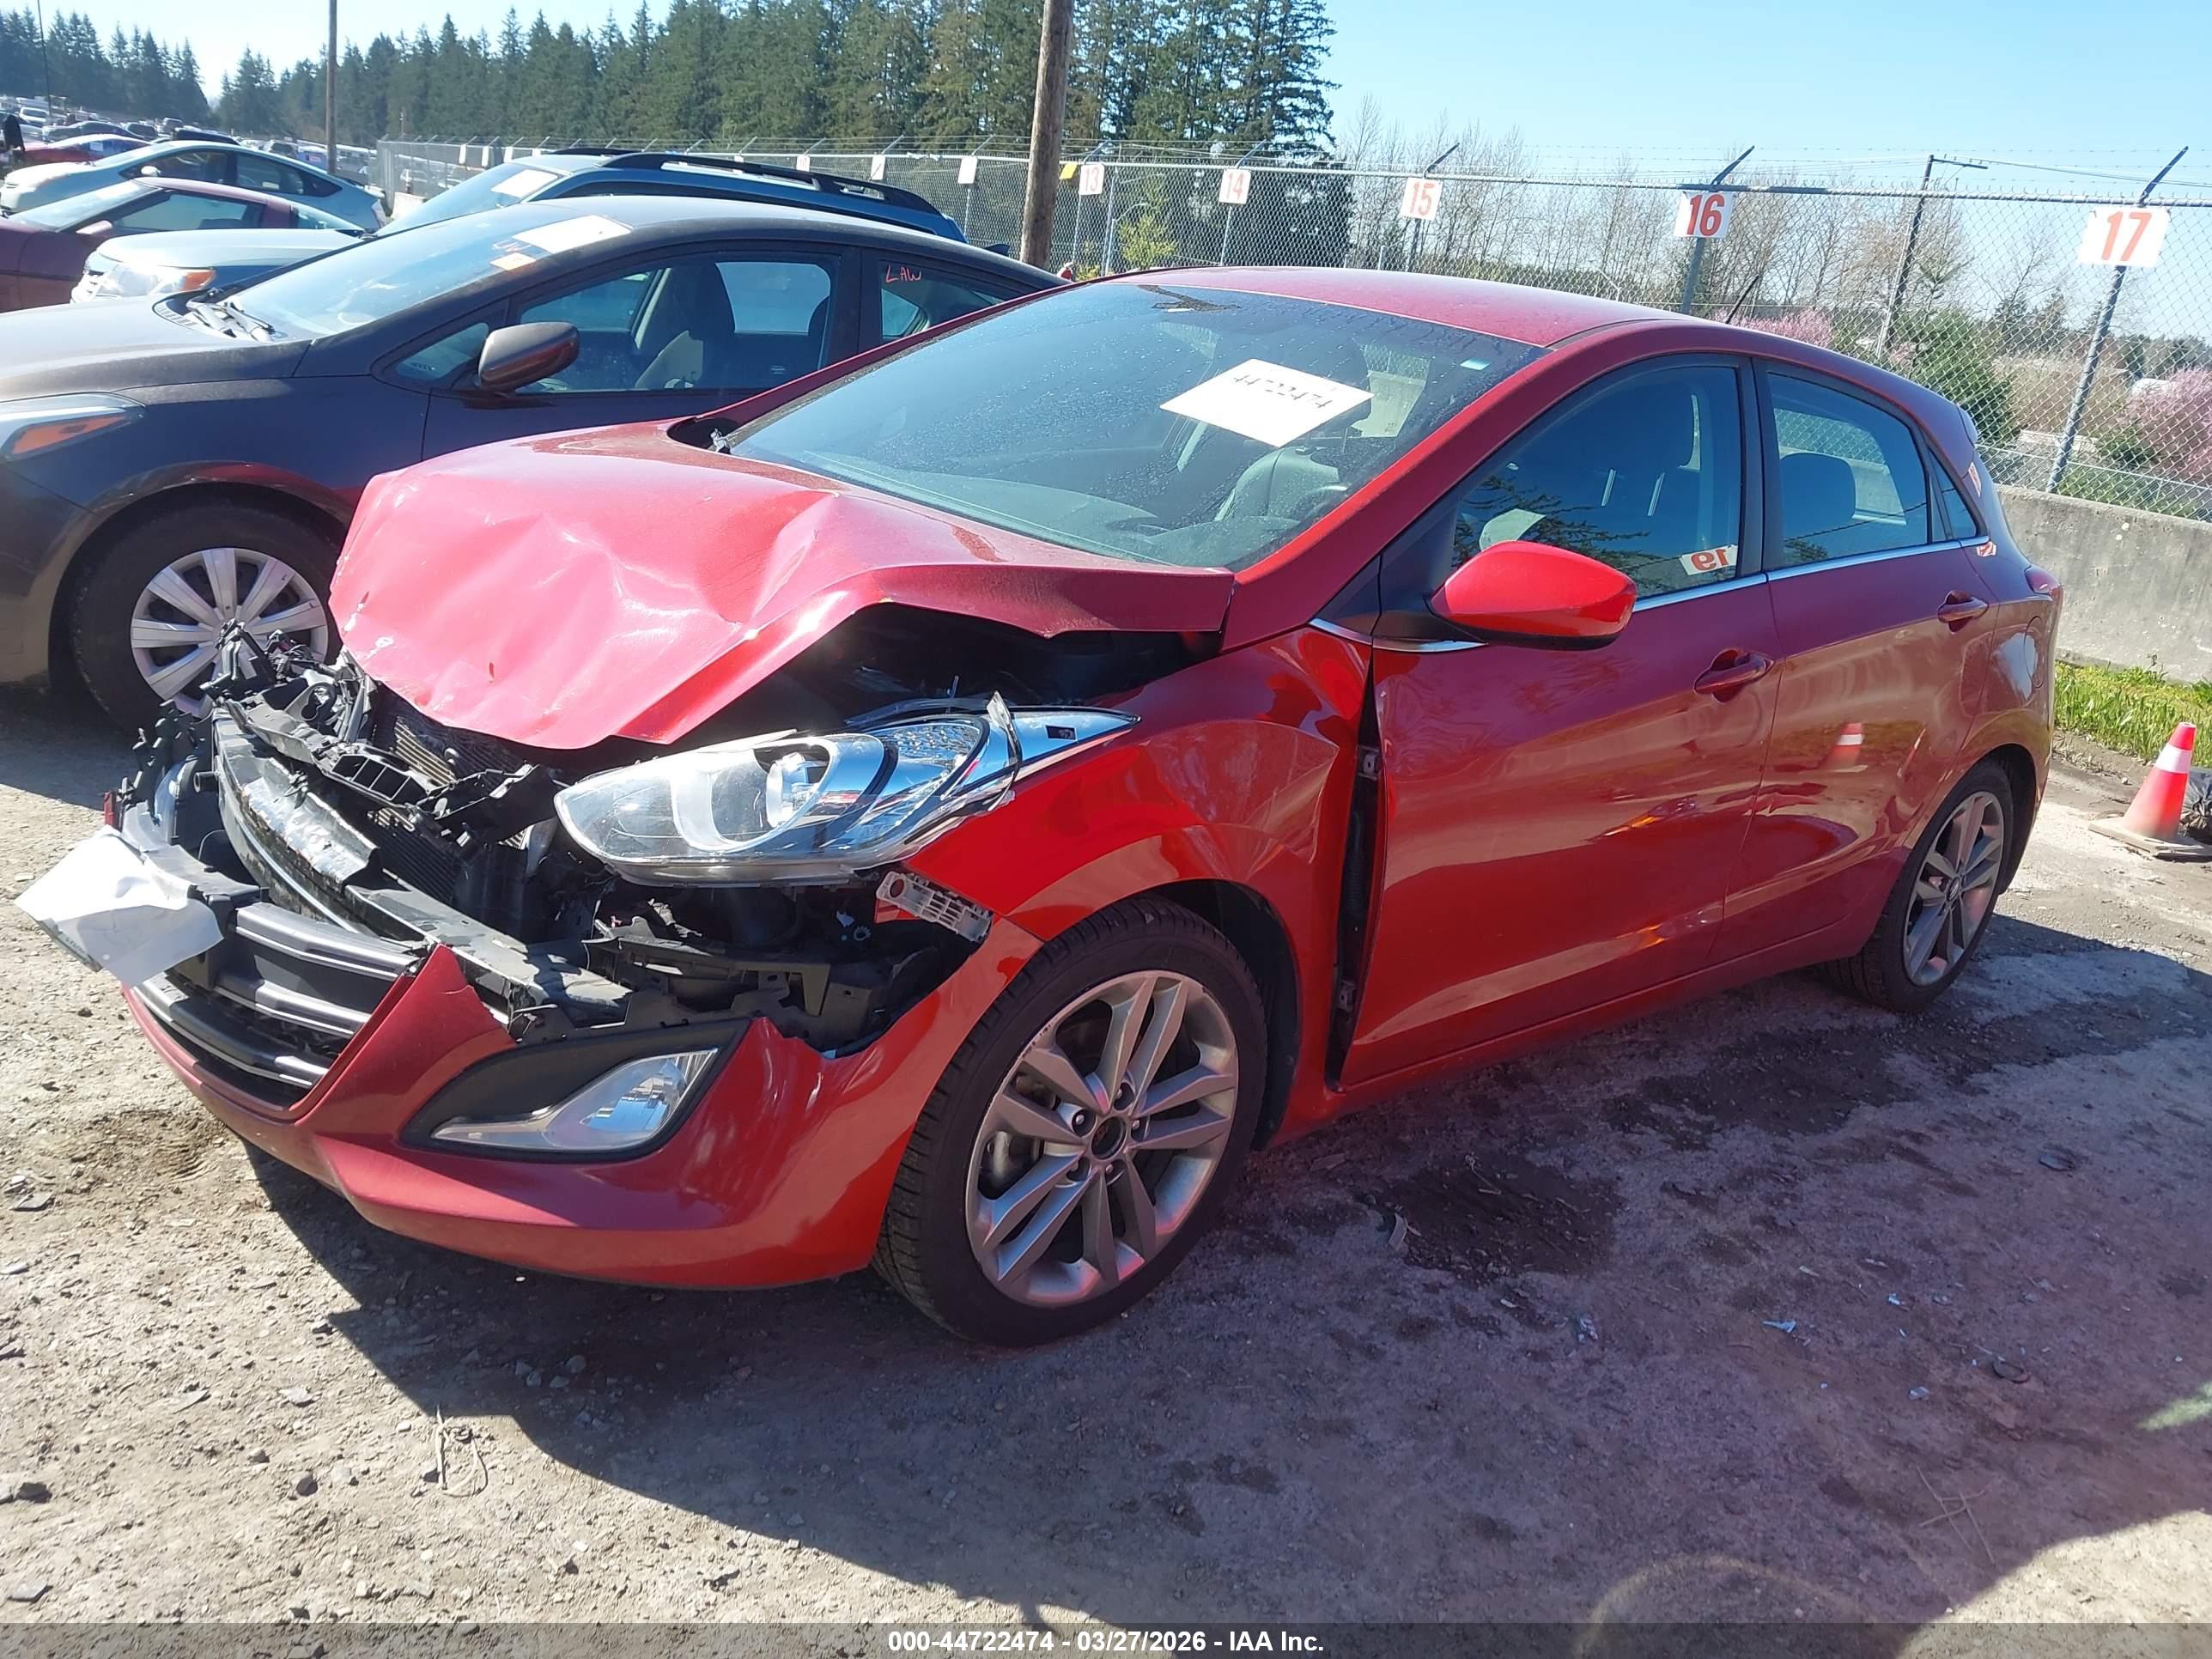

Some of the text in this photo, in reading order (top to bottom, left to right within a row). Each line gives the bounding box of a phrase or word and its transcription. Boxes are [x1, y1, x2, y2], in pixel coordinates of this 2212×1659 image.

[1085, 167, 1100, 192] 13
[1226, 172, 1245, 200] 14
[1409, 180, 1435, 216] 15
[1686, 193, 1725, 237] 16
[2101, 211, 2152, 261] 17
[885, 264, 921, 283] LAW
